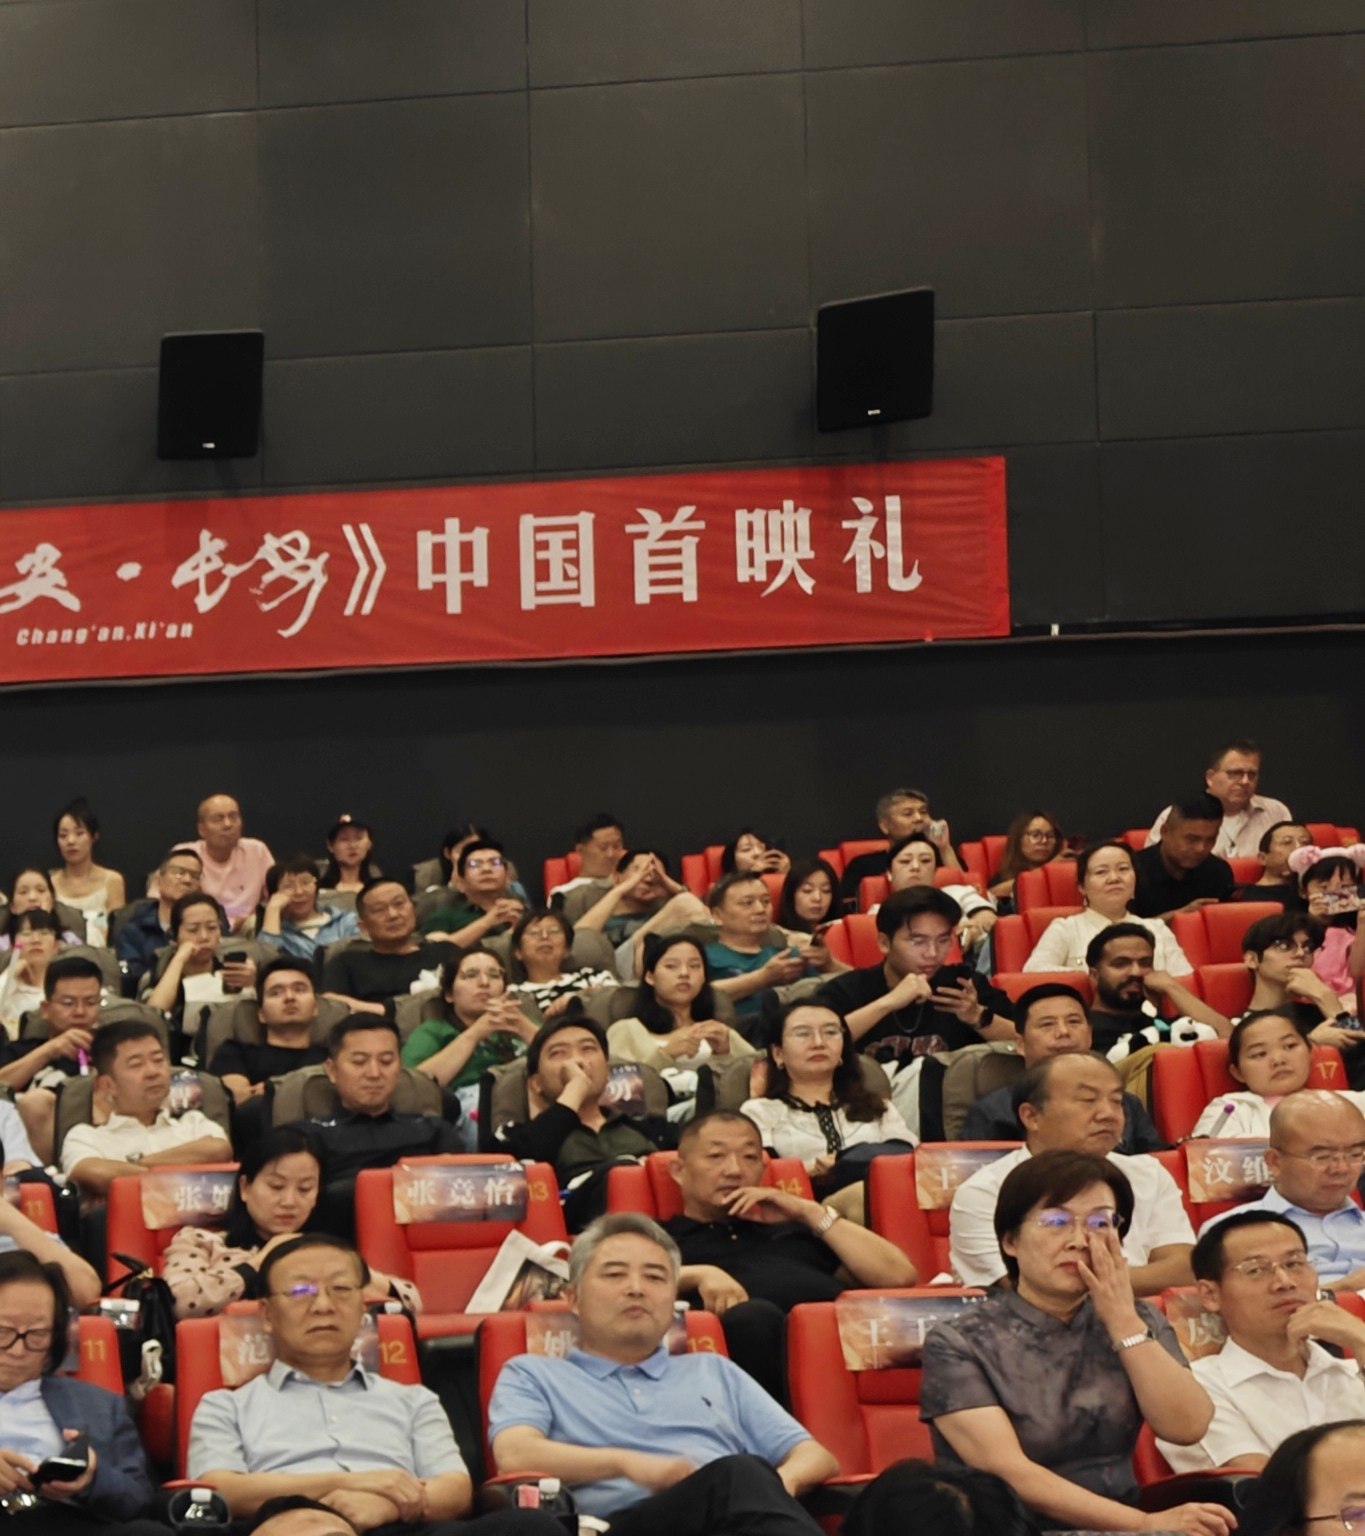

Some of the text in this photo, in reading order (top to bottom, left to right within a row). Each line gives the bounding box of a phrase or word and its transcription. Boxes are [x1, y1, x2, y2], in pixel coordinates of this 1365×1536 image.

[1317, 1061, 1338, 1079] 17
[527, 1181, 550, 1202] 13
[83, 1339, 106, 1362] 11
[378, 1340, 407, 1364] 12
